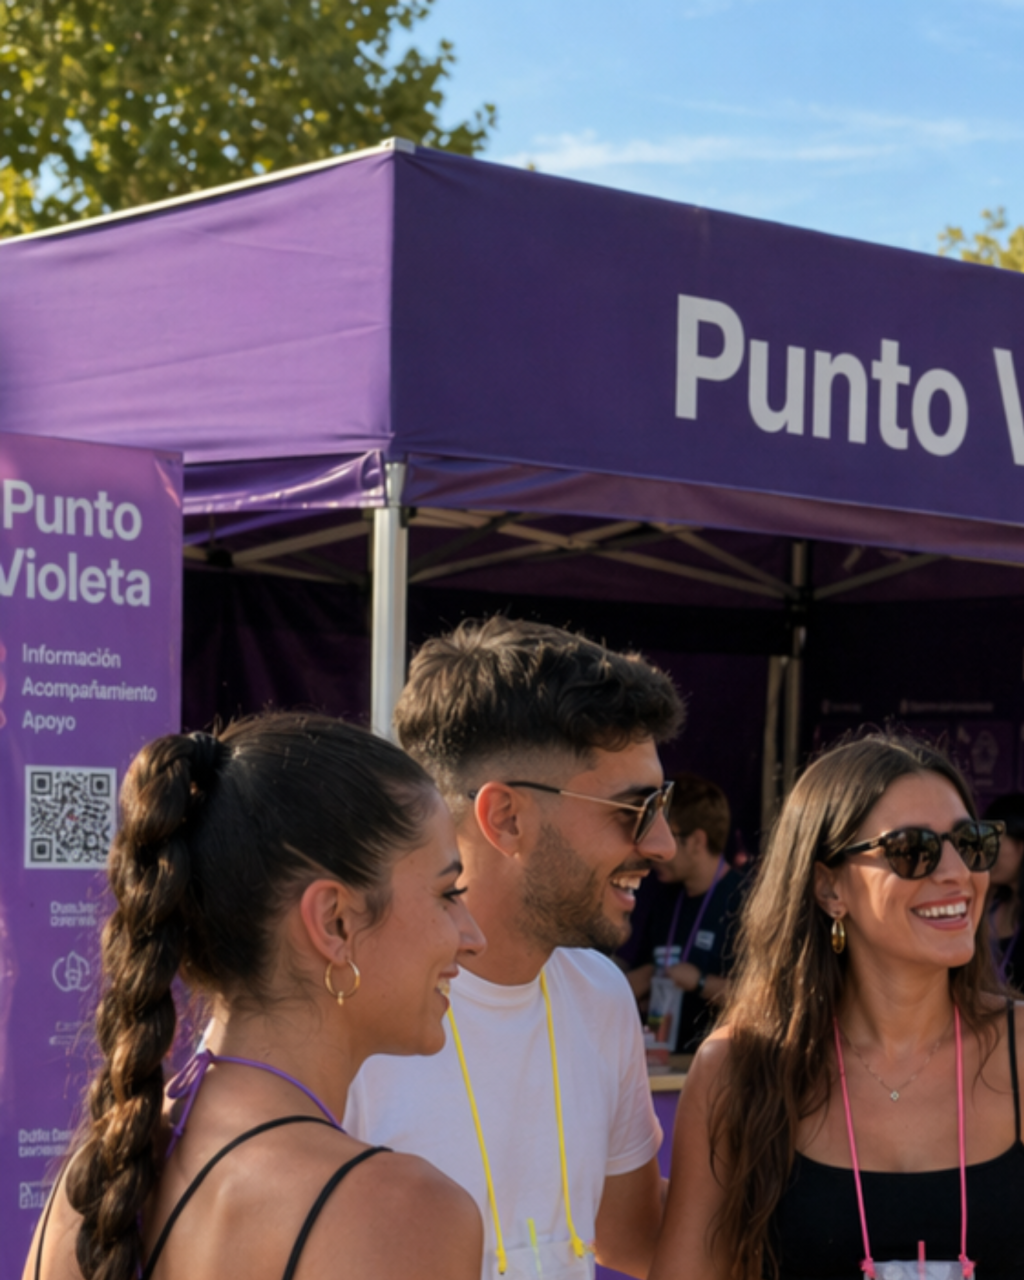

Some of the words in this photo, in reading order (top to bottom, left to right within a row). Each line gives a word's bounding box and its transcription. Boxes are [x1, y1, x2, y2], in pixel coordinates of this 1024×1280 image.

[675, 294, 968, 457] Punto
[3, 479, 142, 541] Punto
[0, 548, 151, 607] Violeta
[22, 643, 121, 669] Información
[22, 676, 157, 702] Acompañamiento
[22, 710, 76, 735] Apoyo
